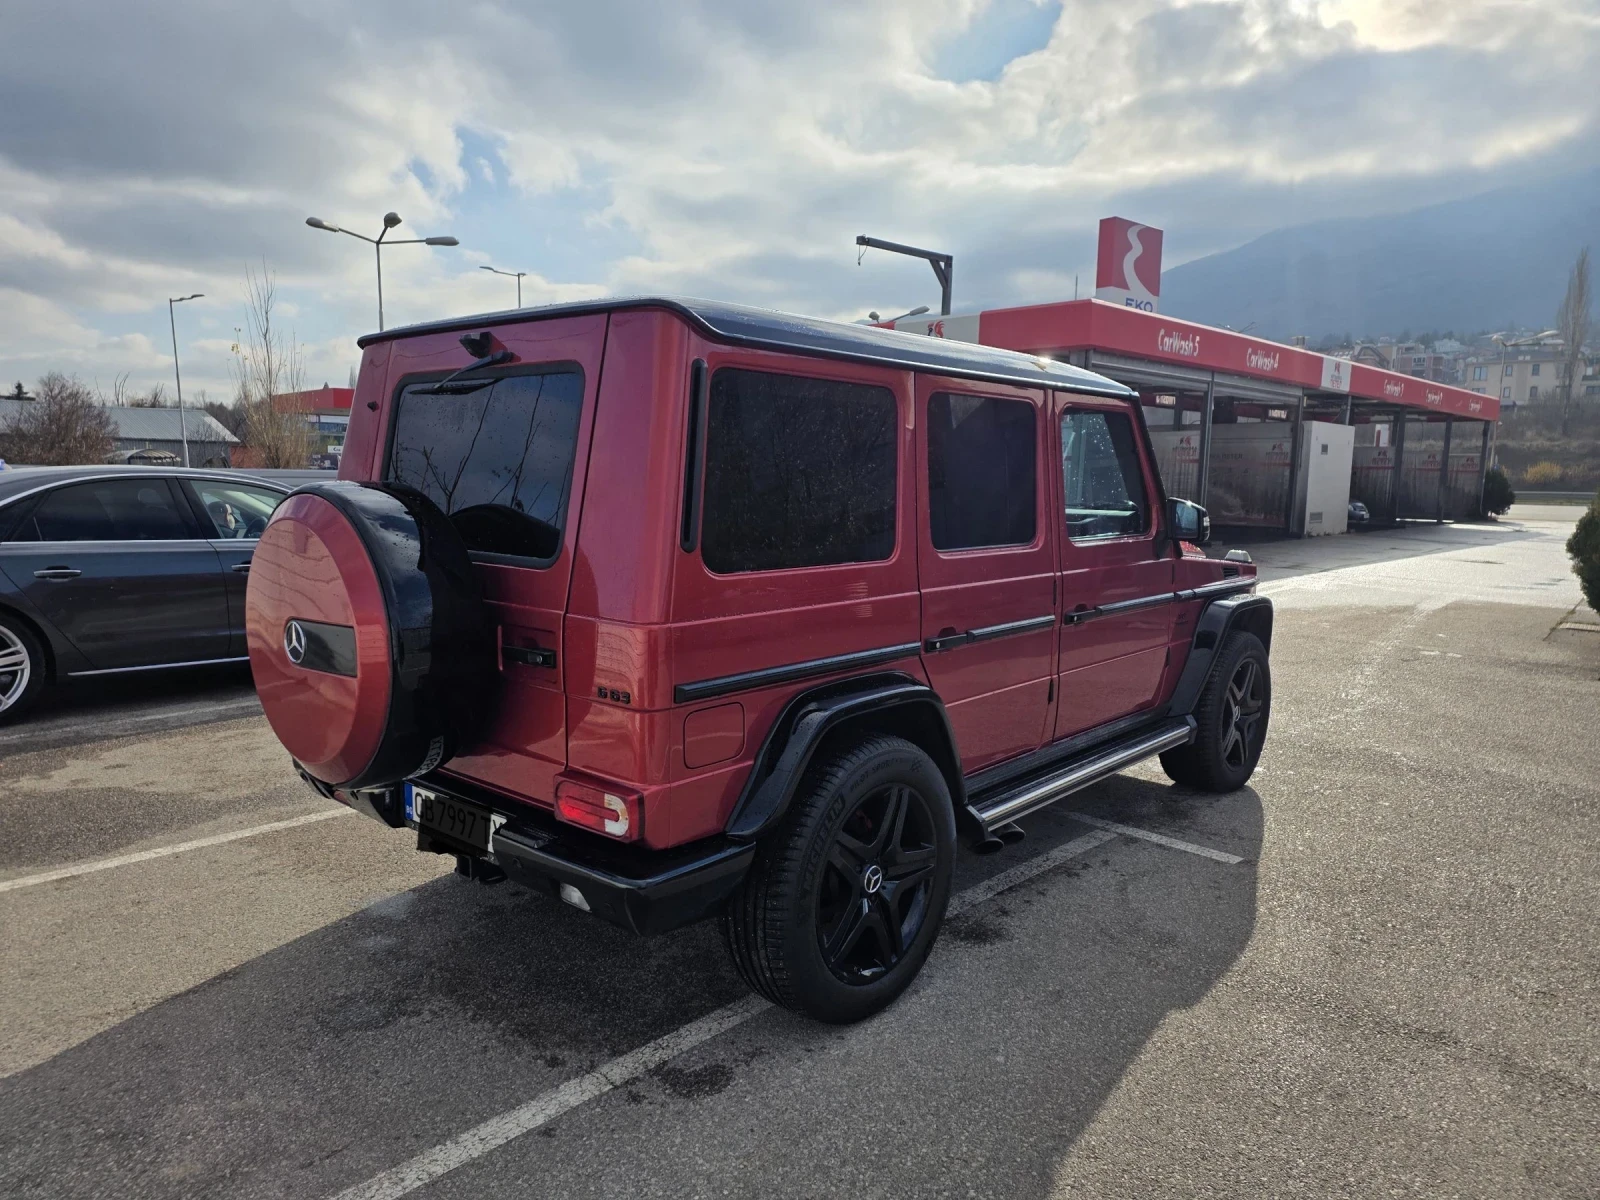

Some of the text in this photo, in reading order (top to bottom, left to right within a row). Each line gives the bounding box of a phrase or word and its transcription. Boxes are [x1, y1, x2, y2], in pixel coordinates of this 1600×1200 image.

[1158, 329, 1200, 357] CarWash 5
[1246, 348, 1279, 371] CarWash 4
[437, 800, 476, 838] 7997
